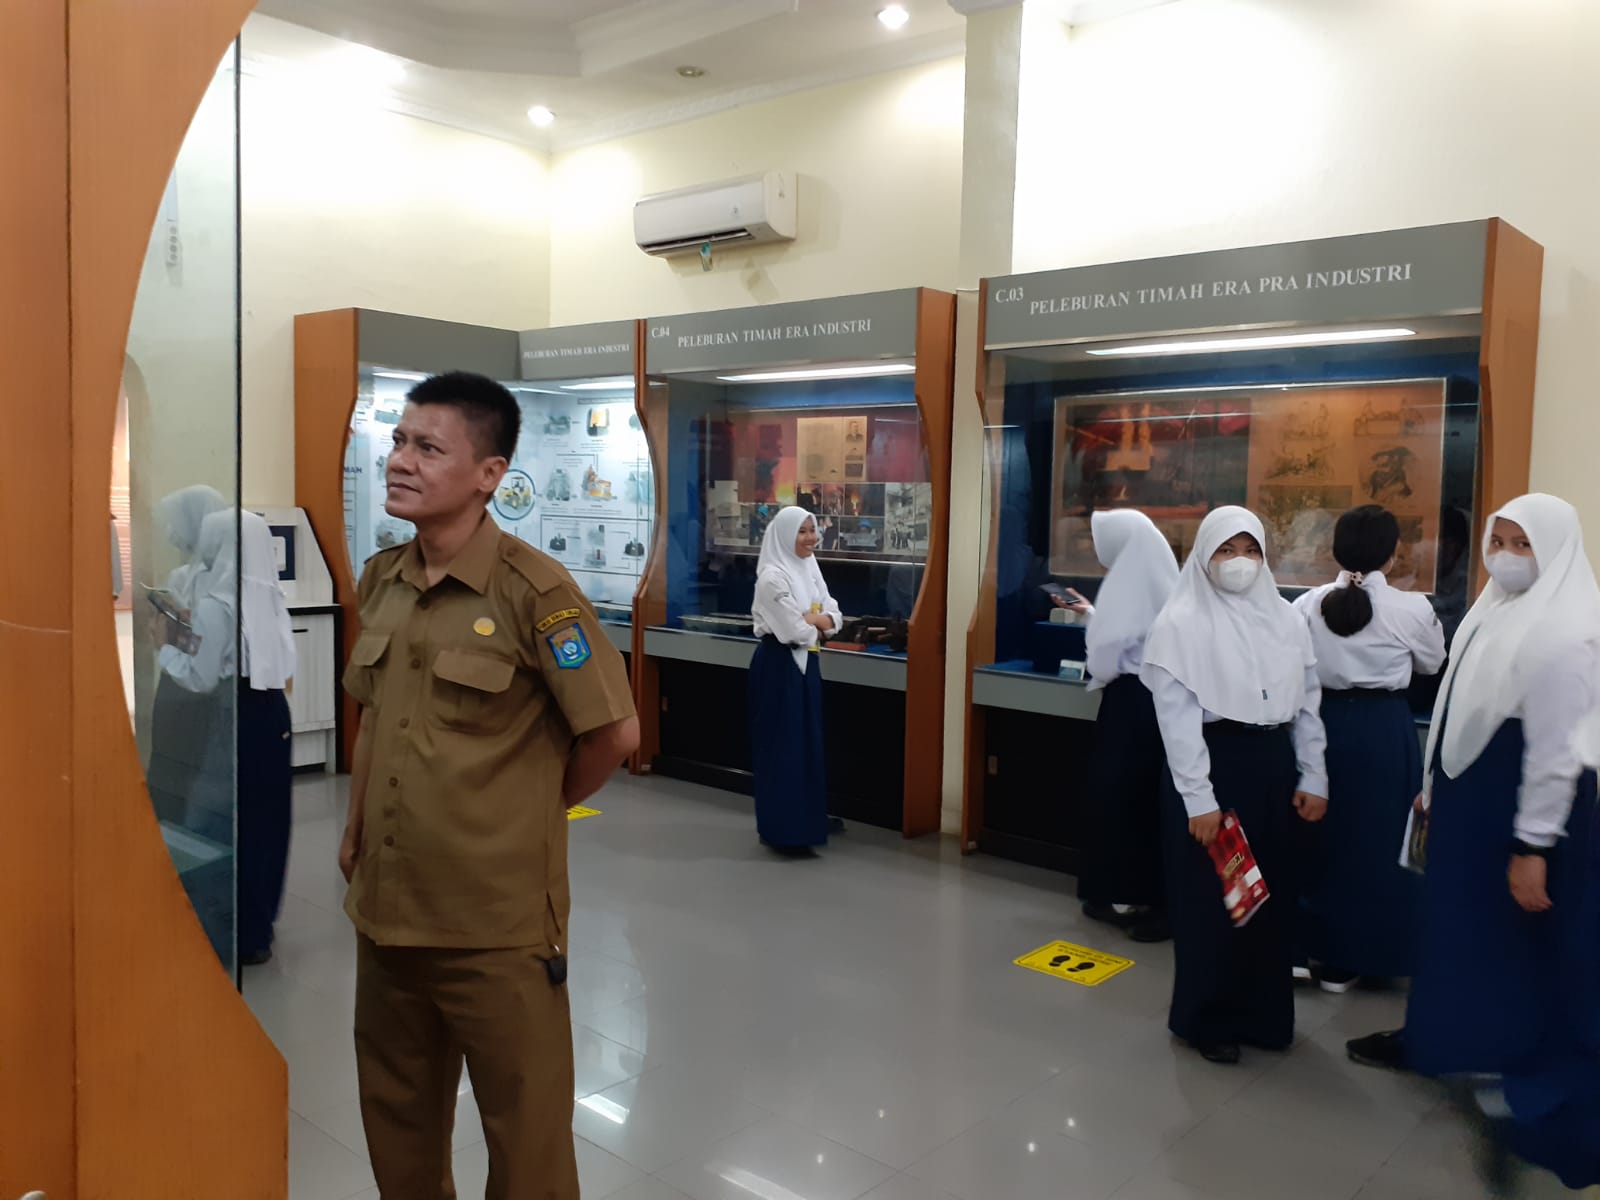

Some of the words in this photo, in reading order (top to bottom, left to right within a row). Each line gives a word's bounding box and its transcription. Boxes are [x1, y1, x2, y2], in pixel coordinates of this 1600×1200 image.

[995, 287, 1024, 303] C.03
[1029, 291, 1129, 315] PELEBURAN
[1137, 283, 1203, 304] TIMAH
[1212, 280, 1252, 297] ERA
[1259, 274, 1298, 292] PRA
[1305, 263, 1412, 289] INDUSTRI
[651, 326, 670, 338] C.04
[677, 331, 739, 348] PELEBURAN
[743, 326, 781, 343] TIMAH
[786, 324, 810, 339] ERA
[813, 318, 872, 337] INDUSTRI
